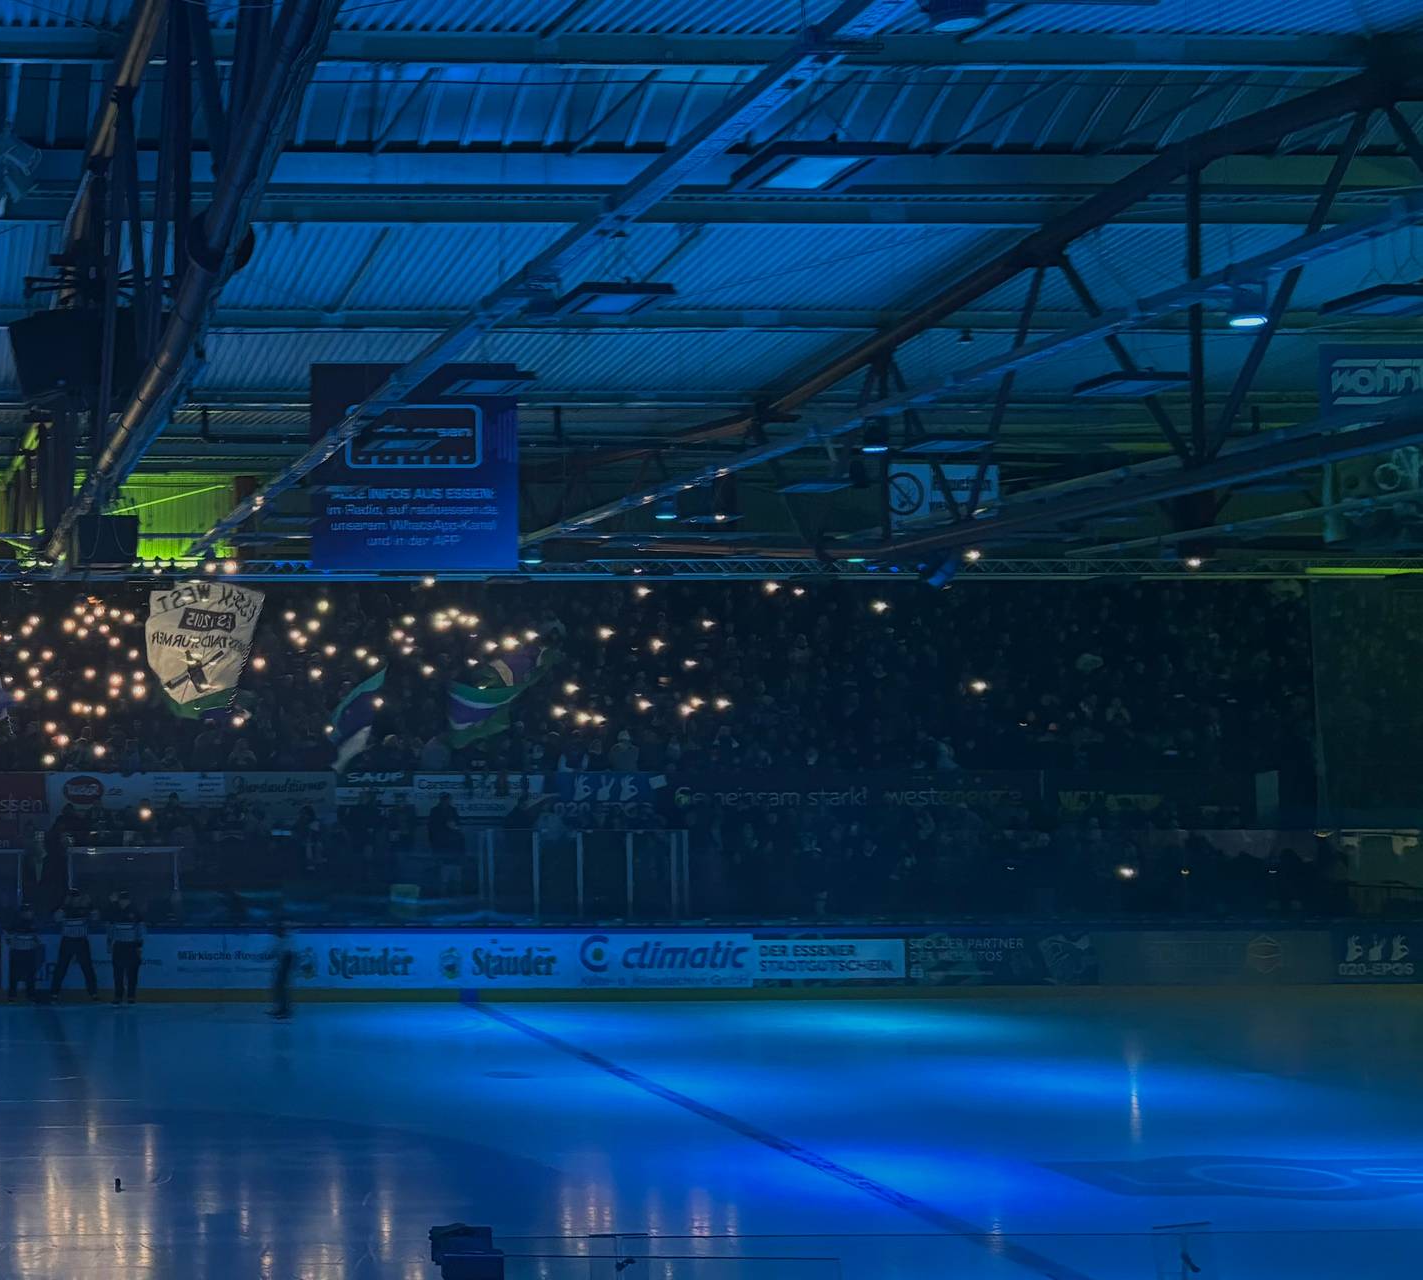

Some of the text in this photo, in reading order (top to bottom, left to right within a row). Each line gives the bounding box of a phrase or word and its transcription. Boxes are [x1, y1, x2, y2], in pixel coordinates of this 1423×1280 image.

[622, 940, 750, 969] climatic
[759, 944, 787, 957] DER
[967, 937, 1025, 949] PARTNER
[327, 946, 415, 979] Stauder
[471, 946, 558, 979] Stauder
